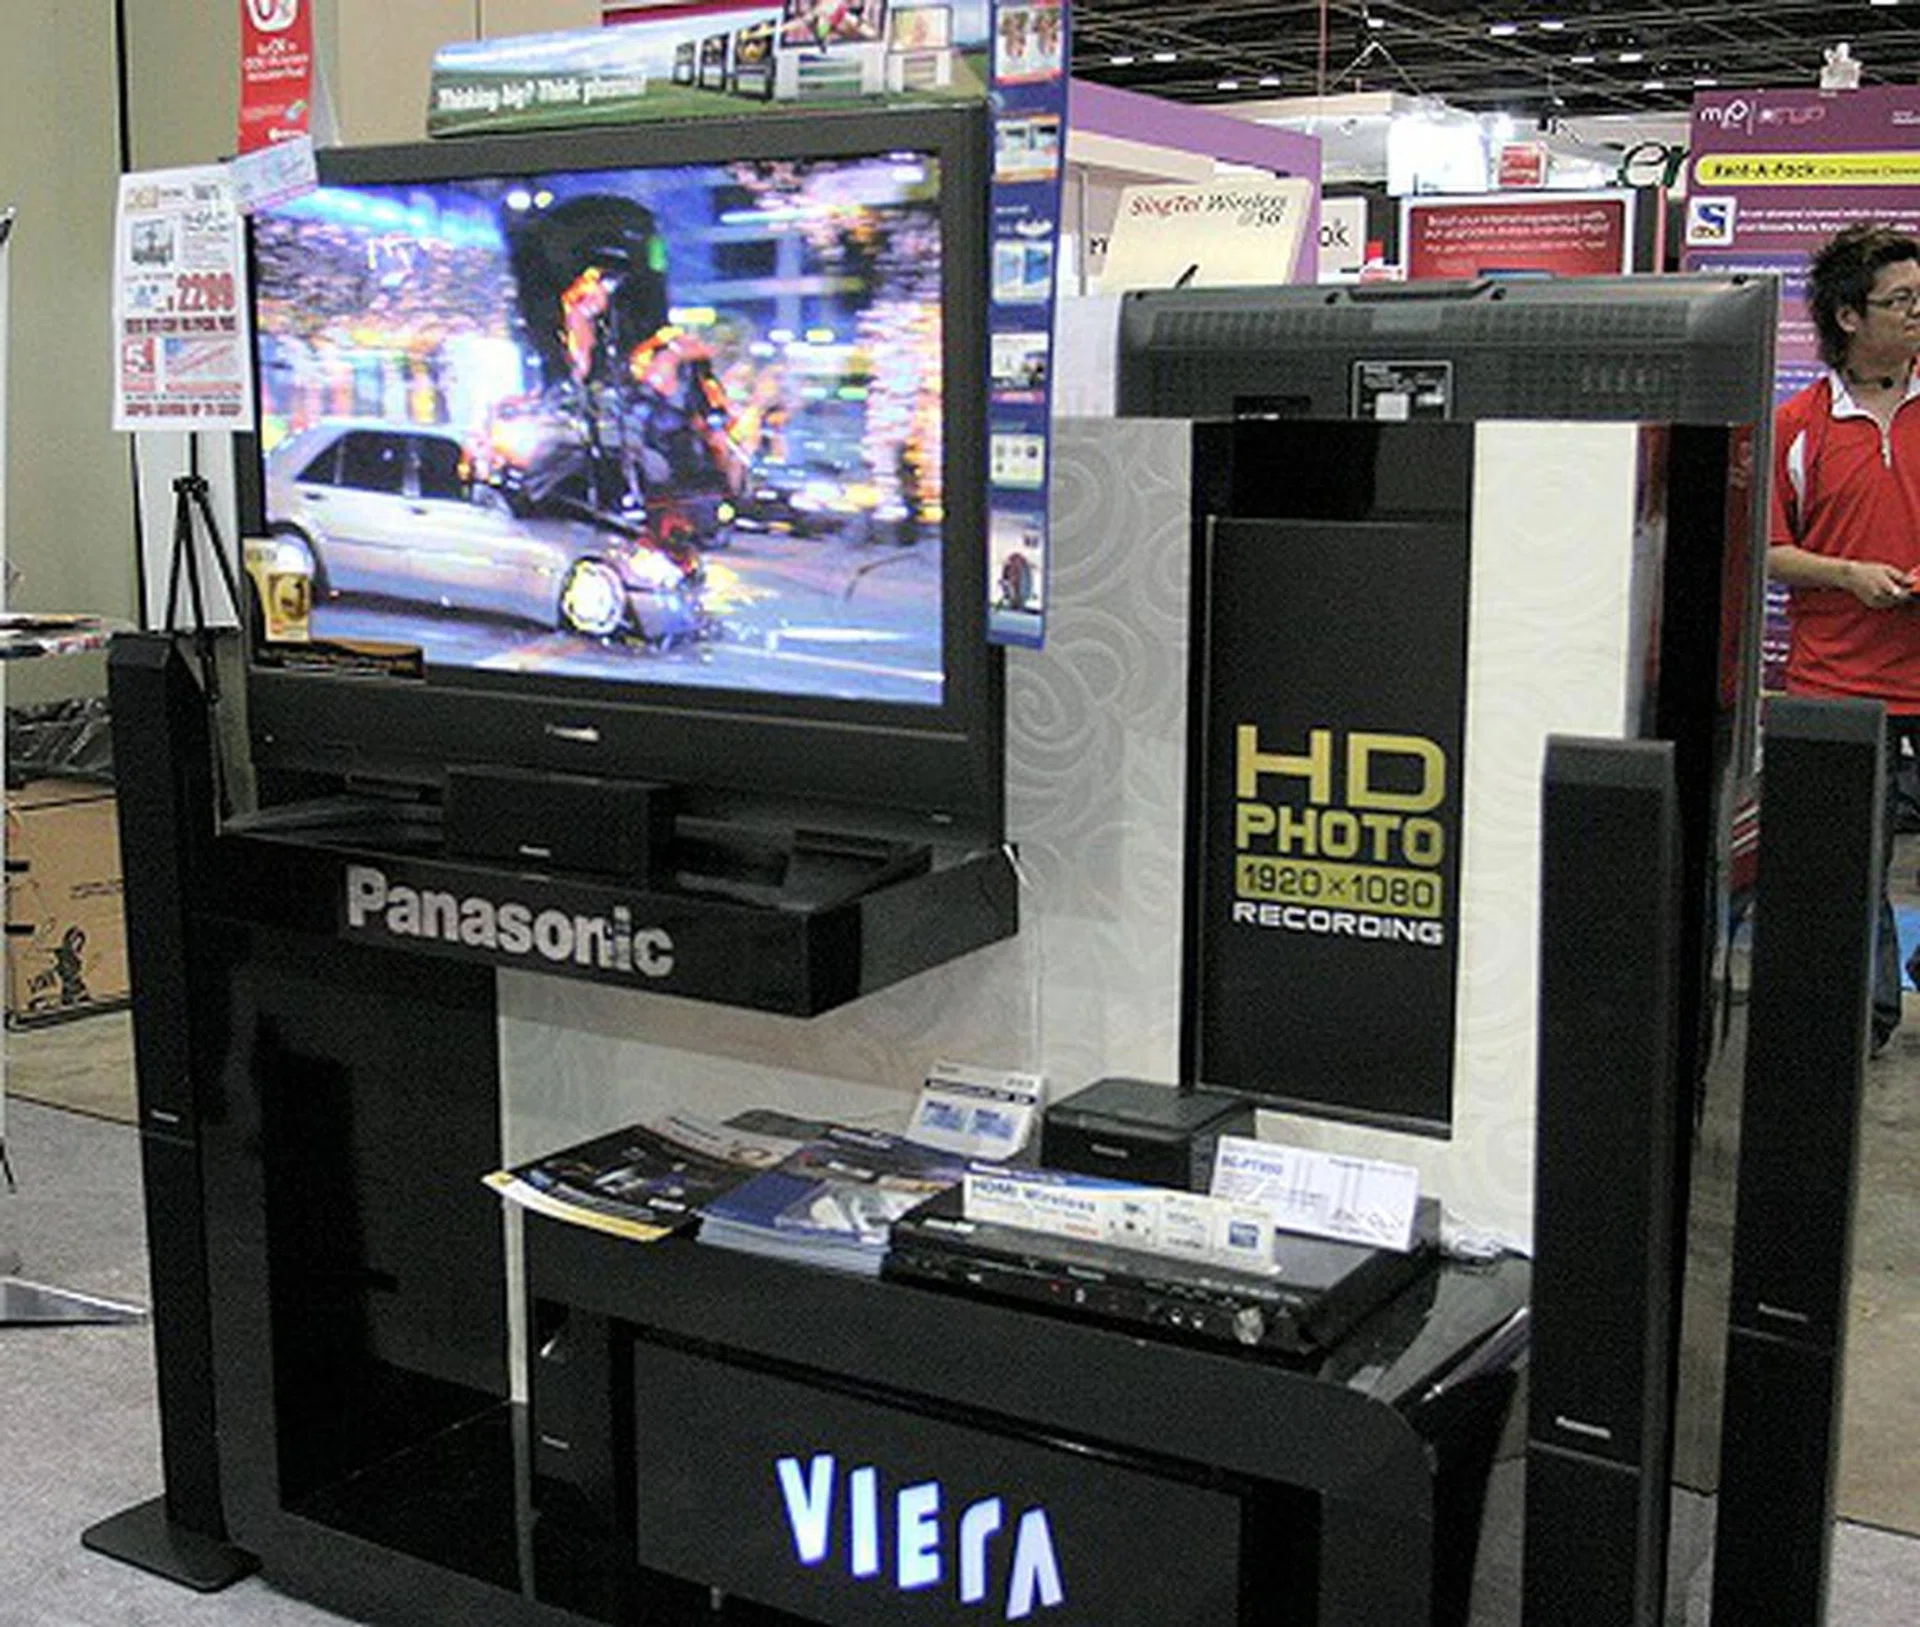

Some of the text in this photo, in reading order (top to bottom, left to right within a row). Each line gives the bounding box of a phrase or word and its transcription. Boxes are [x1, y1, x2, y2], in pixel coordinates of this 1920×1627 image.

[438, 85, 500, 113] Thinking
[537, 77, 580, 102] Think
[1130, 195, 1203, 217] SingTel
[1237, 724, 1446, 813] HD
[1236, 803, 1444, 868] PHOTO
[347, 865, 674, 977] Panasonic
[1233, 902, 1443, 945] RECORDING
[776, 1455, 1064, 1620] VIERA
